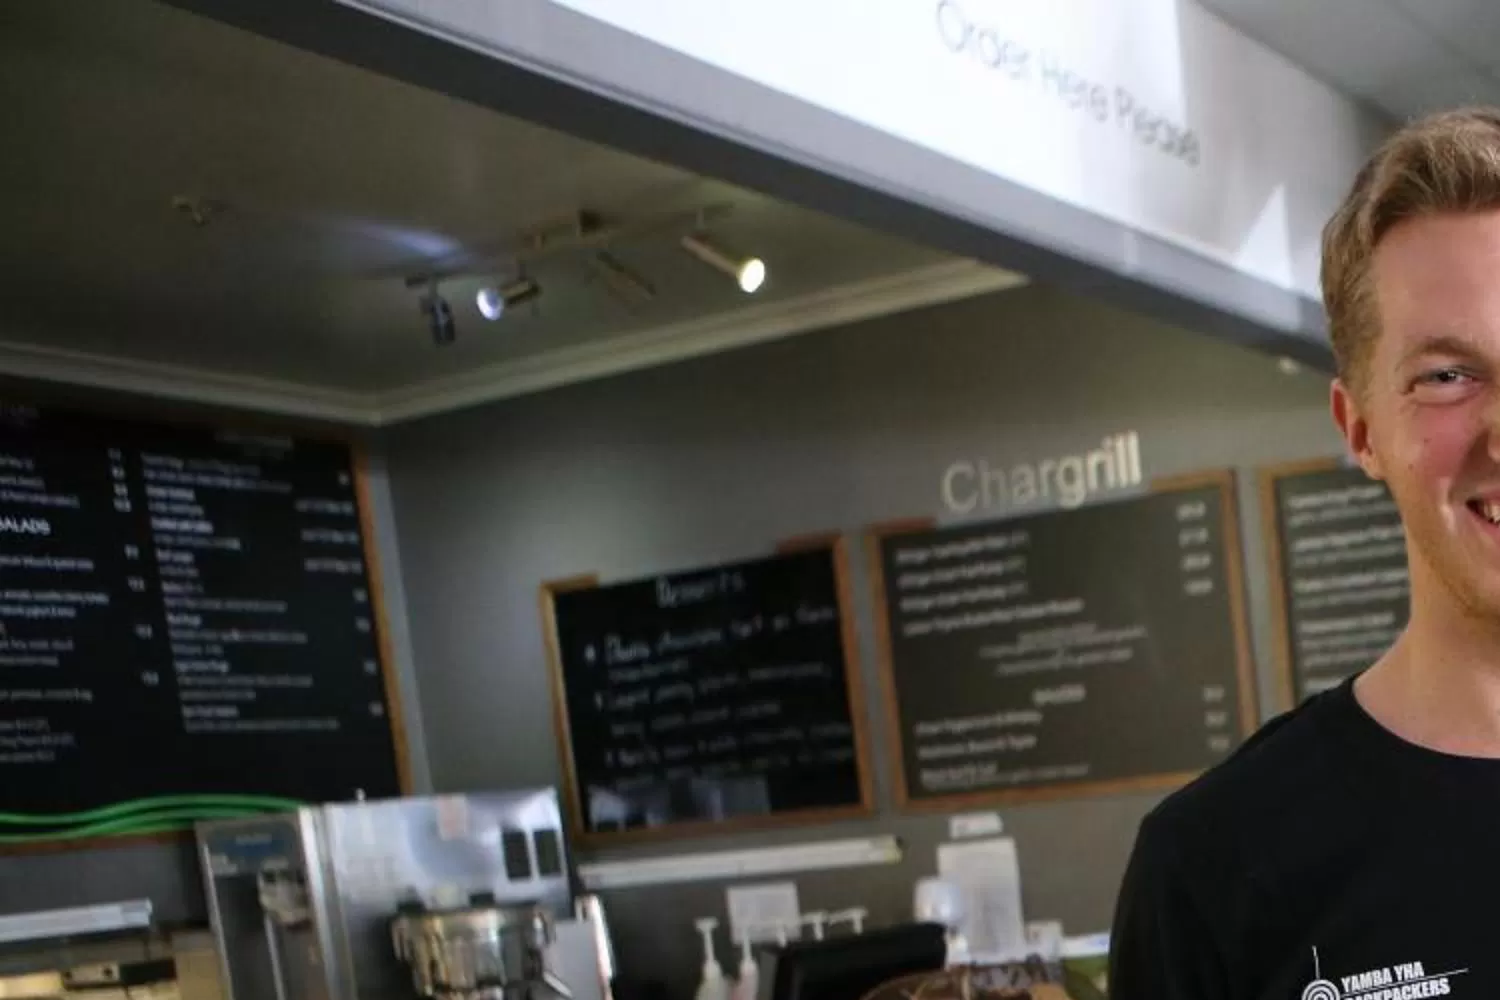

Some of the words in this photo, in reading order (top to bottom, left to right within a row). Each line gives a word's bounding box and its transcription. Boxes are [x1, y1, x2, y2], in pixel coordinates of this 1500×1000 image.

[941, 430, 1143, 511] Chargrill
[1341, 967, 1393, 993] YAMBA
[1393, 961, 1425, 981] YHA
